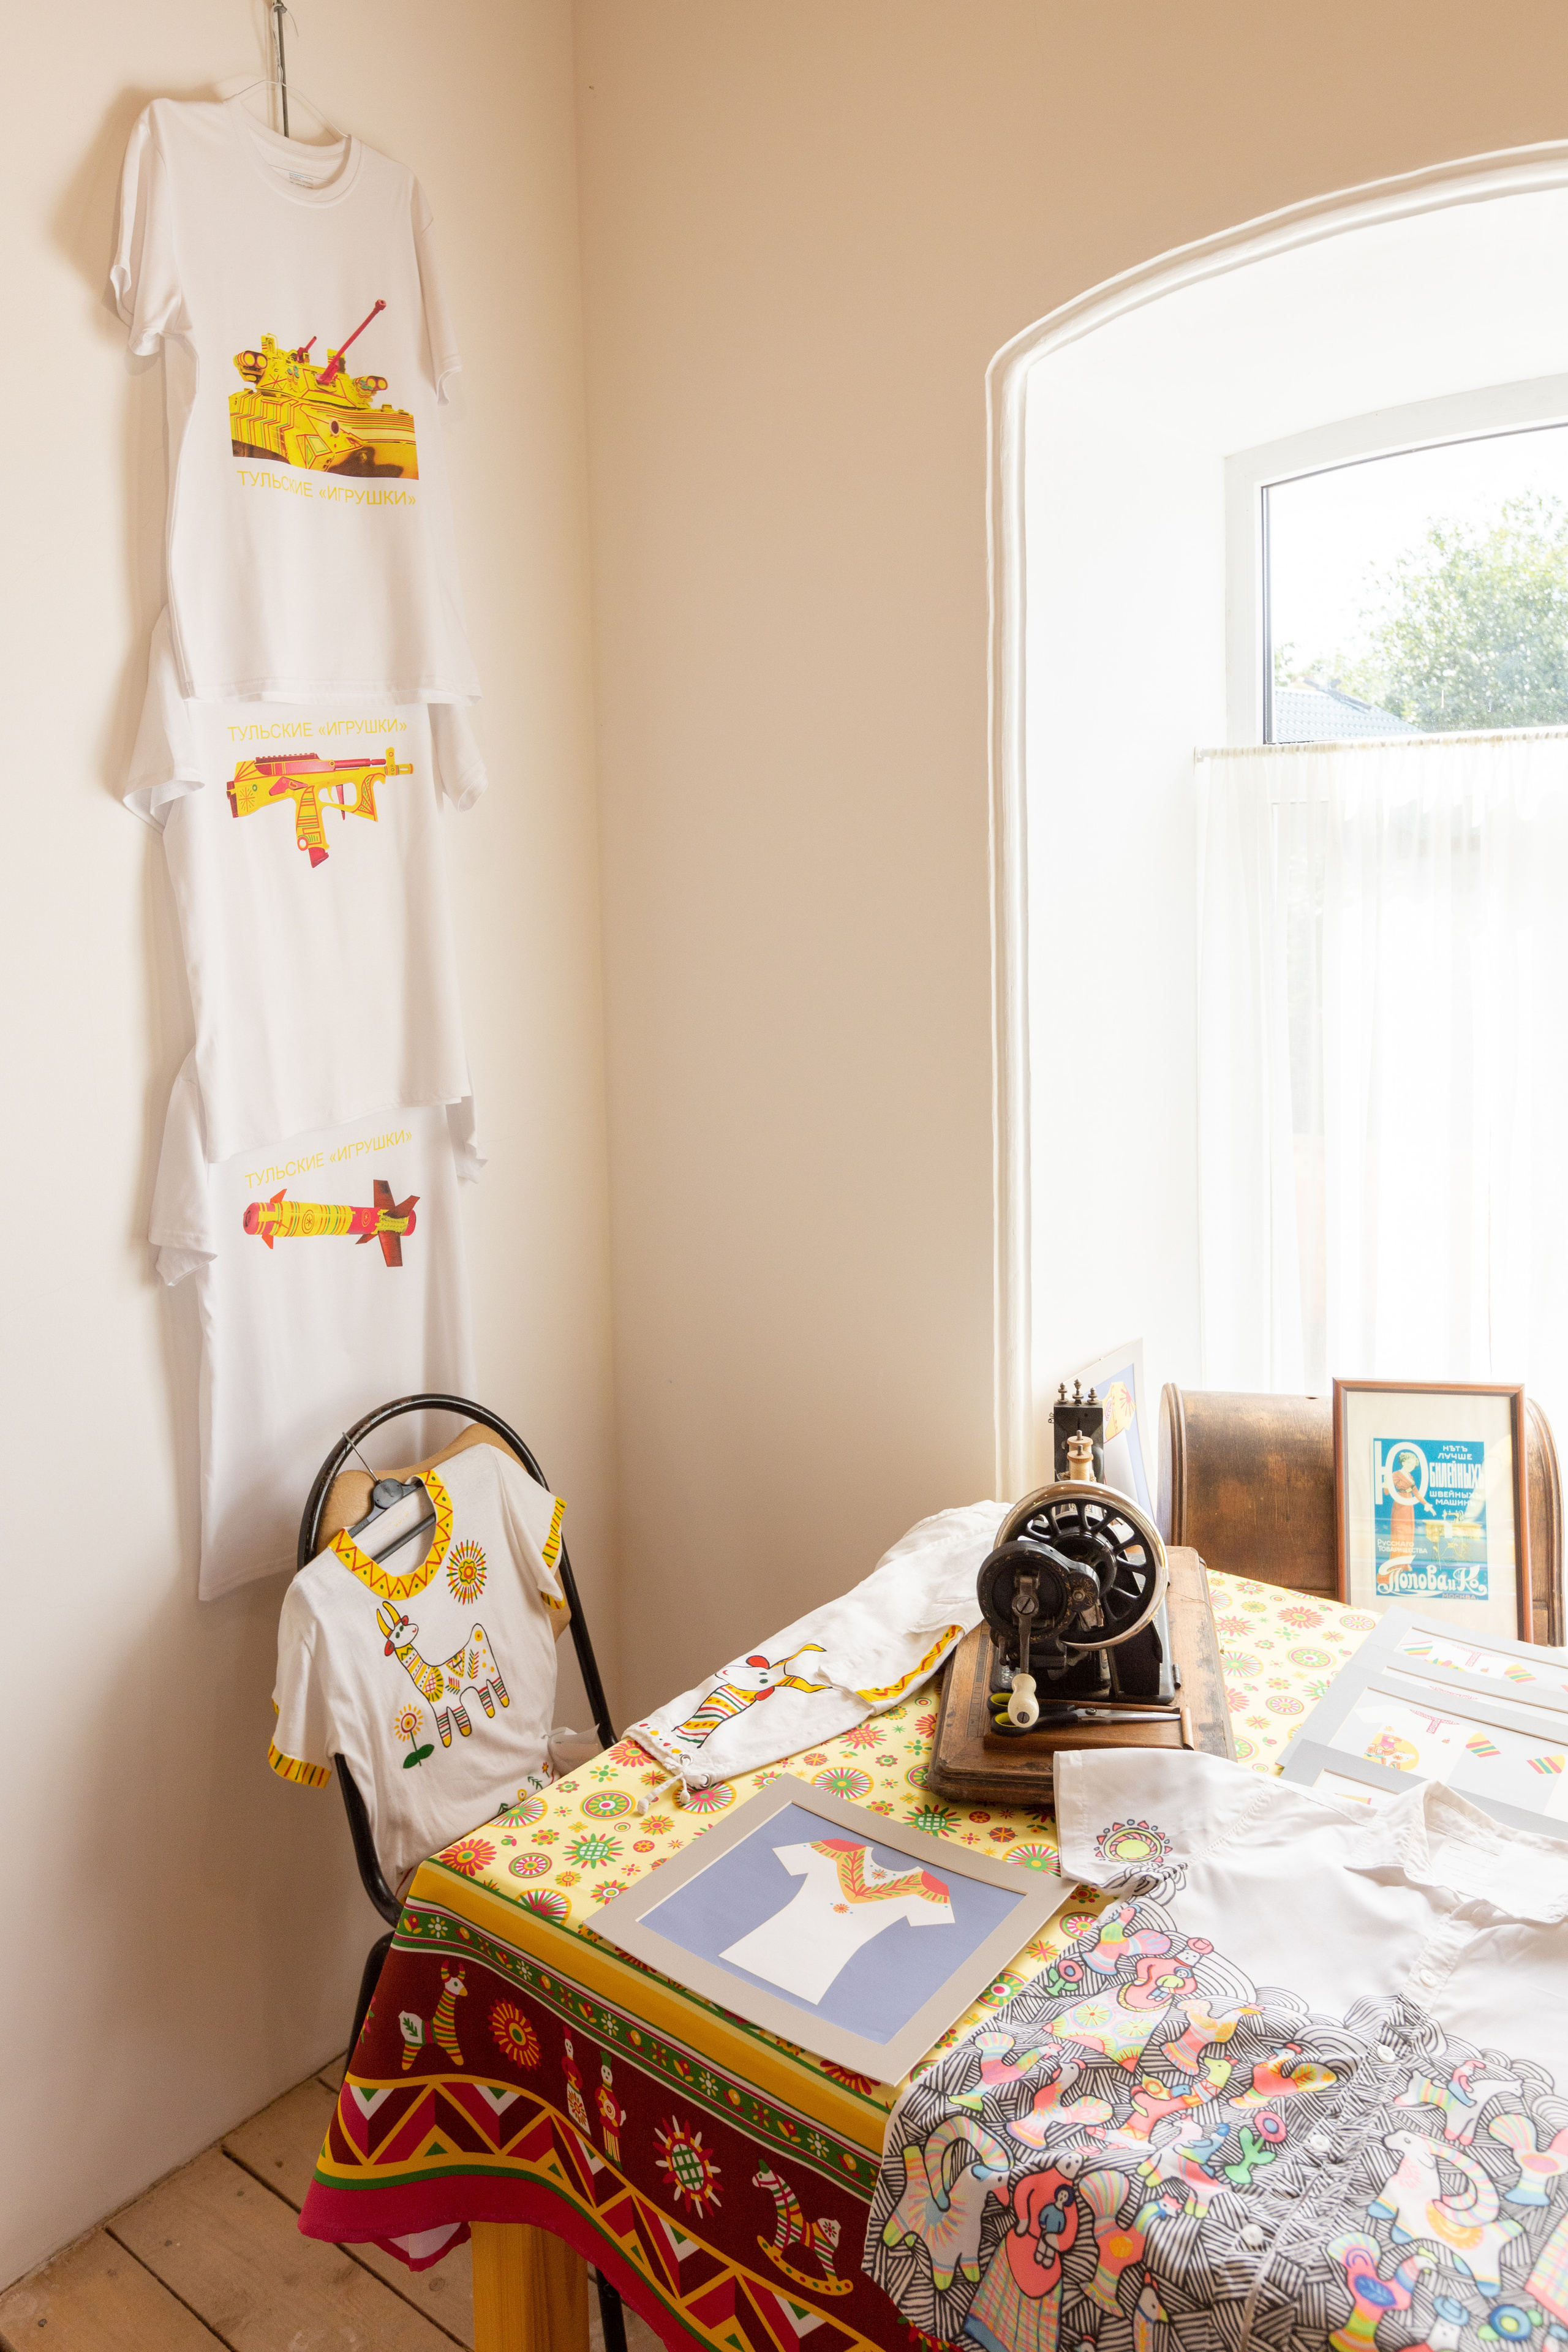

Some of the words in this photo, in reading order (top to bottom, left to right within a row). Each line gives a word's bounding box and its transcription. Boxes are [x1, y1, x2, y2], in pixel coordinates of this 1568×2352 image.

[236, 470, 313, 497] ТУЛЬСКИЕ
[319, 485, 416, 505] «ИГРУШКИ»
[227, 722, 313, 742] ТУЛЬСКИЕ
[318, 718, 407, 736] «ИГРУШКИ»
[244, 1152, 325, 1189] ТУЛЬСКИЕ
[330, 1129, 412, 1163] «ИГРУШКИ»
